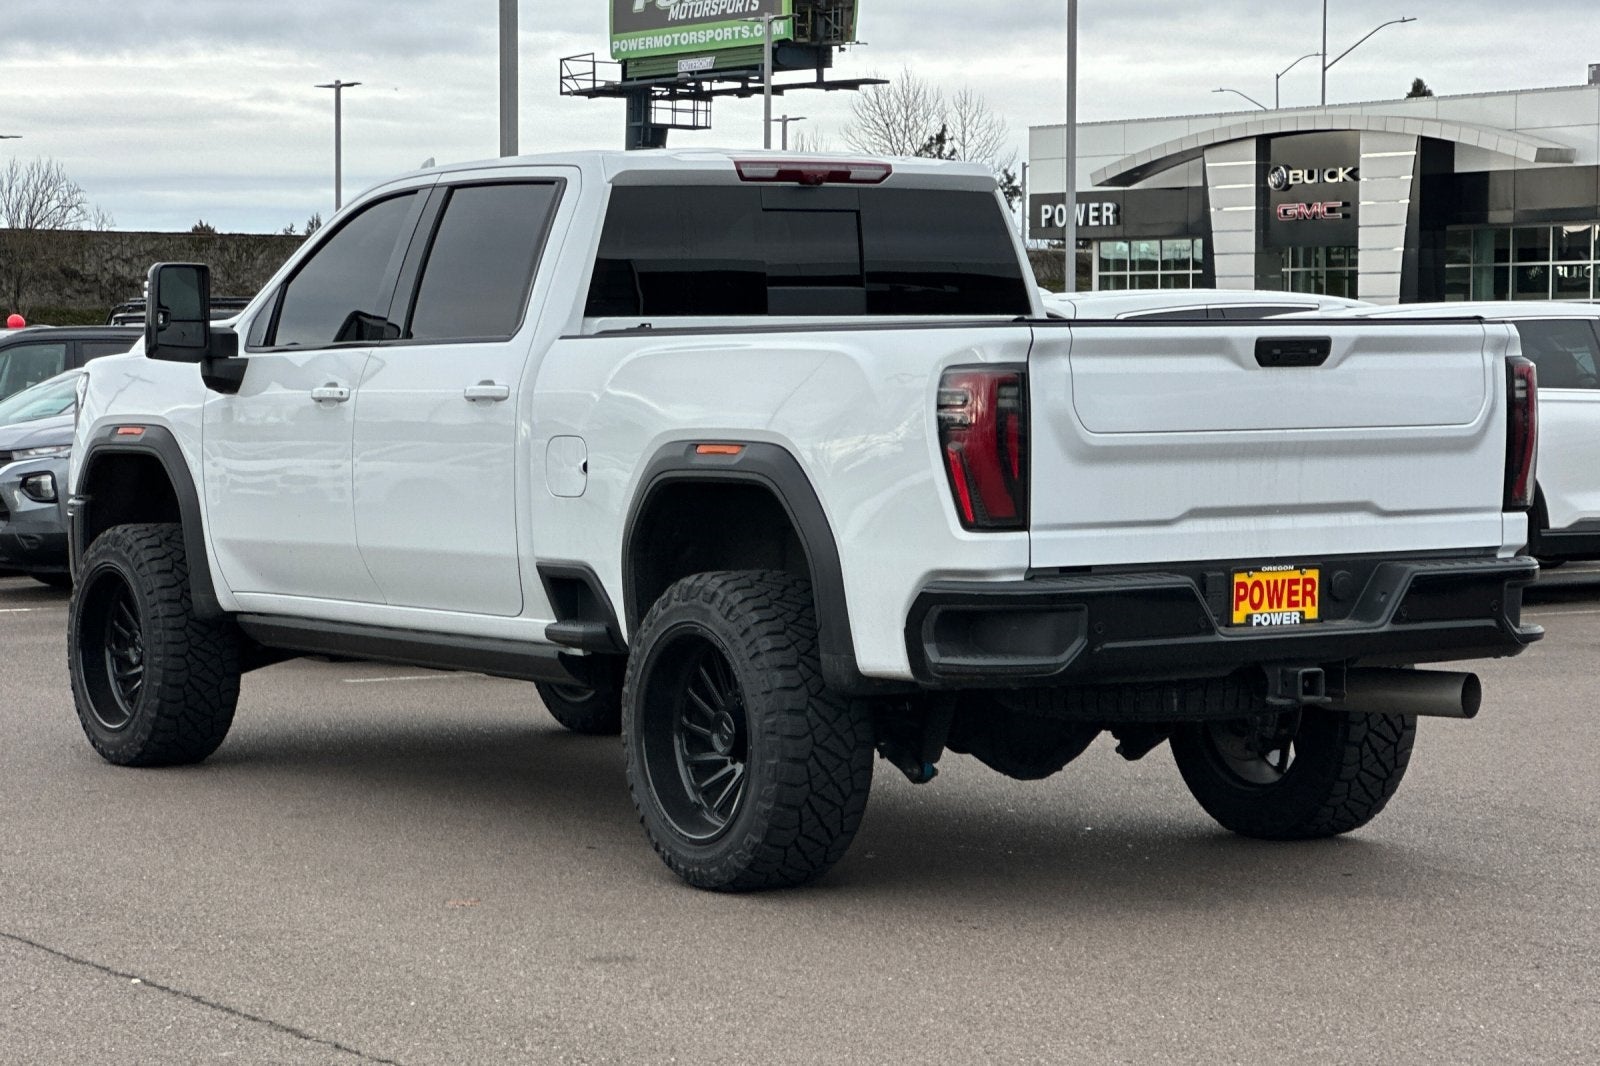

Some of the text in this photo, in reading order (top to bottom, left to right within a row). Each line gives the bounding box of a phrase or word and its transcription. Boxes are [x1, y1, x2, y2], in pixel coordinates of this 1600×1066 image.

[668, 0, 759, 21] MOTORSPORTS
[612, 21, 784, 53] POWERMOTORSPORTS.CM
[1288, 166, 1355, 185] BUICK
[1041, 202, 1115, 228] POWER
[1277, 201, 1342, 221] GMC
[1261, 564, 1295, 572] OREGON
[1234, 577, 1317, 612] POWER
[1252, 611, 1301, 627] POWER
